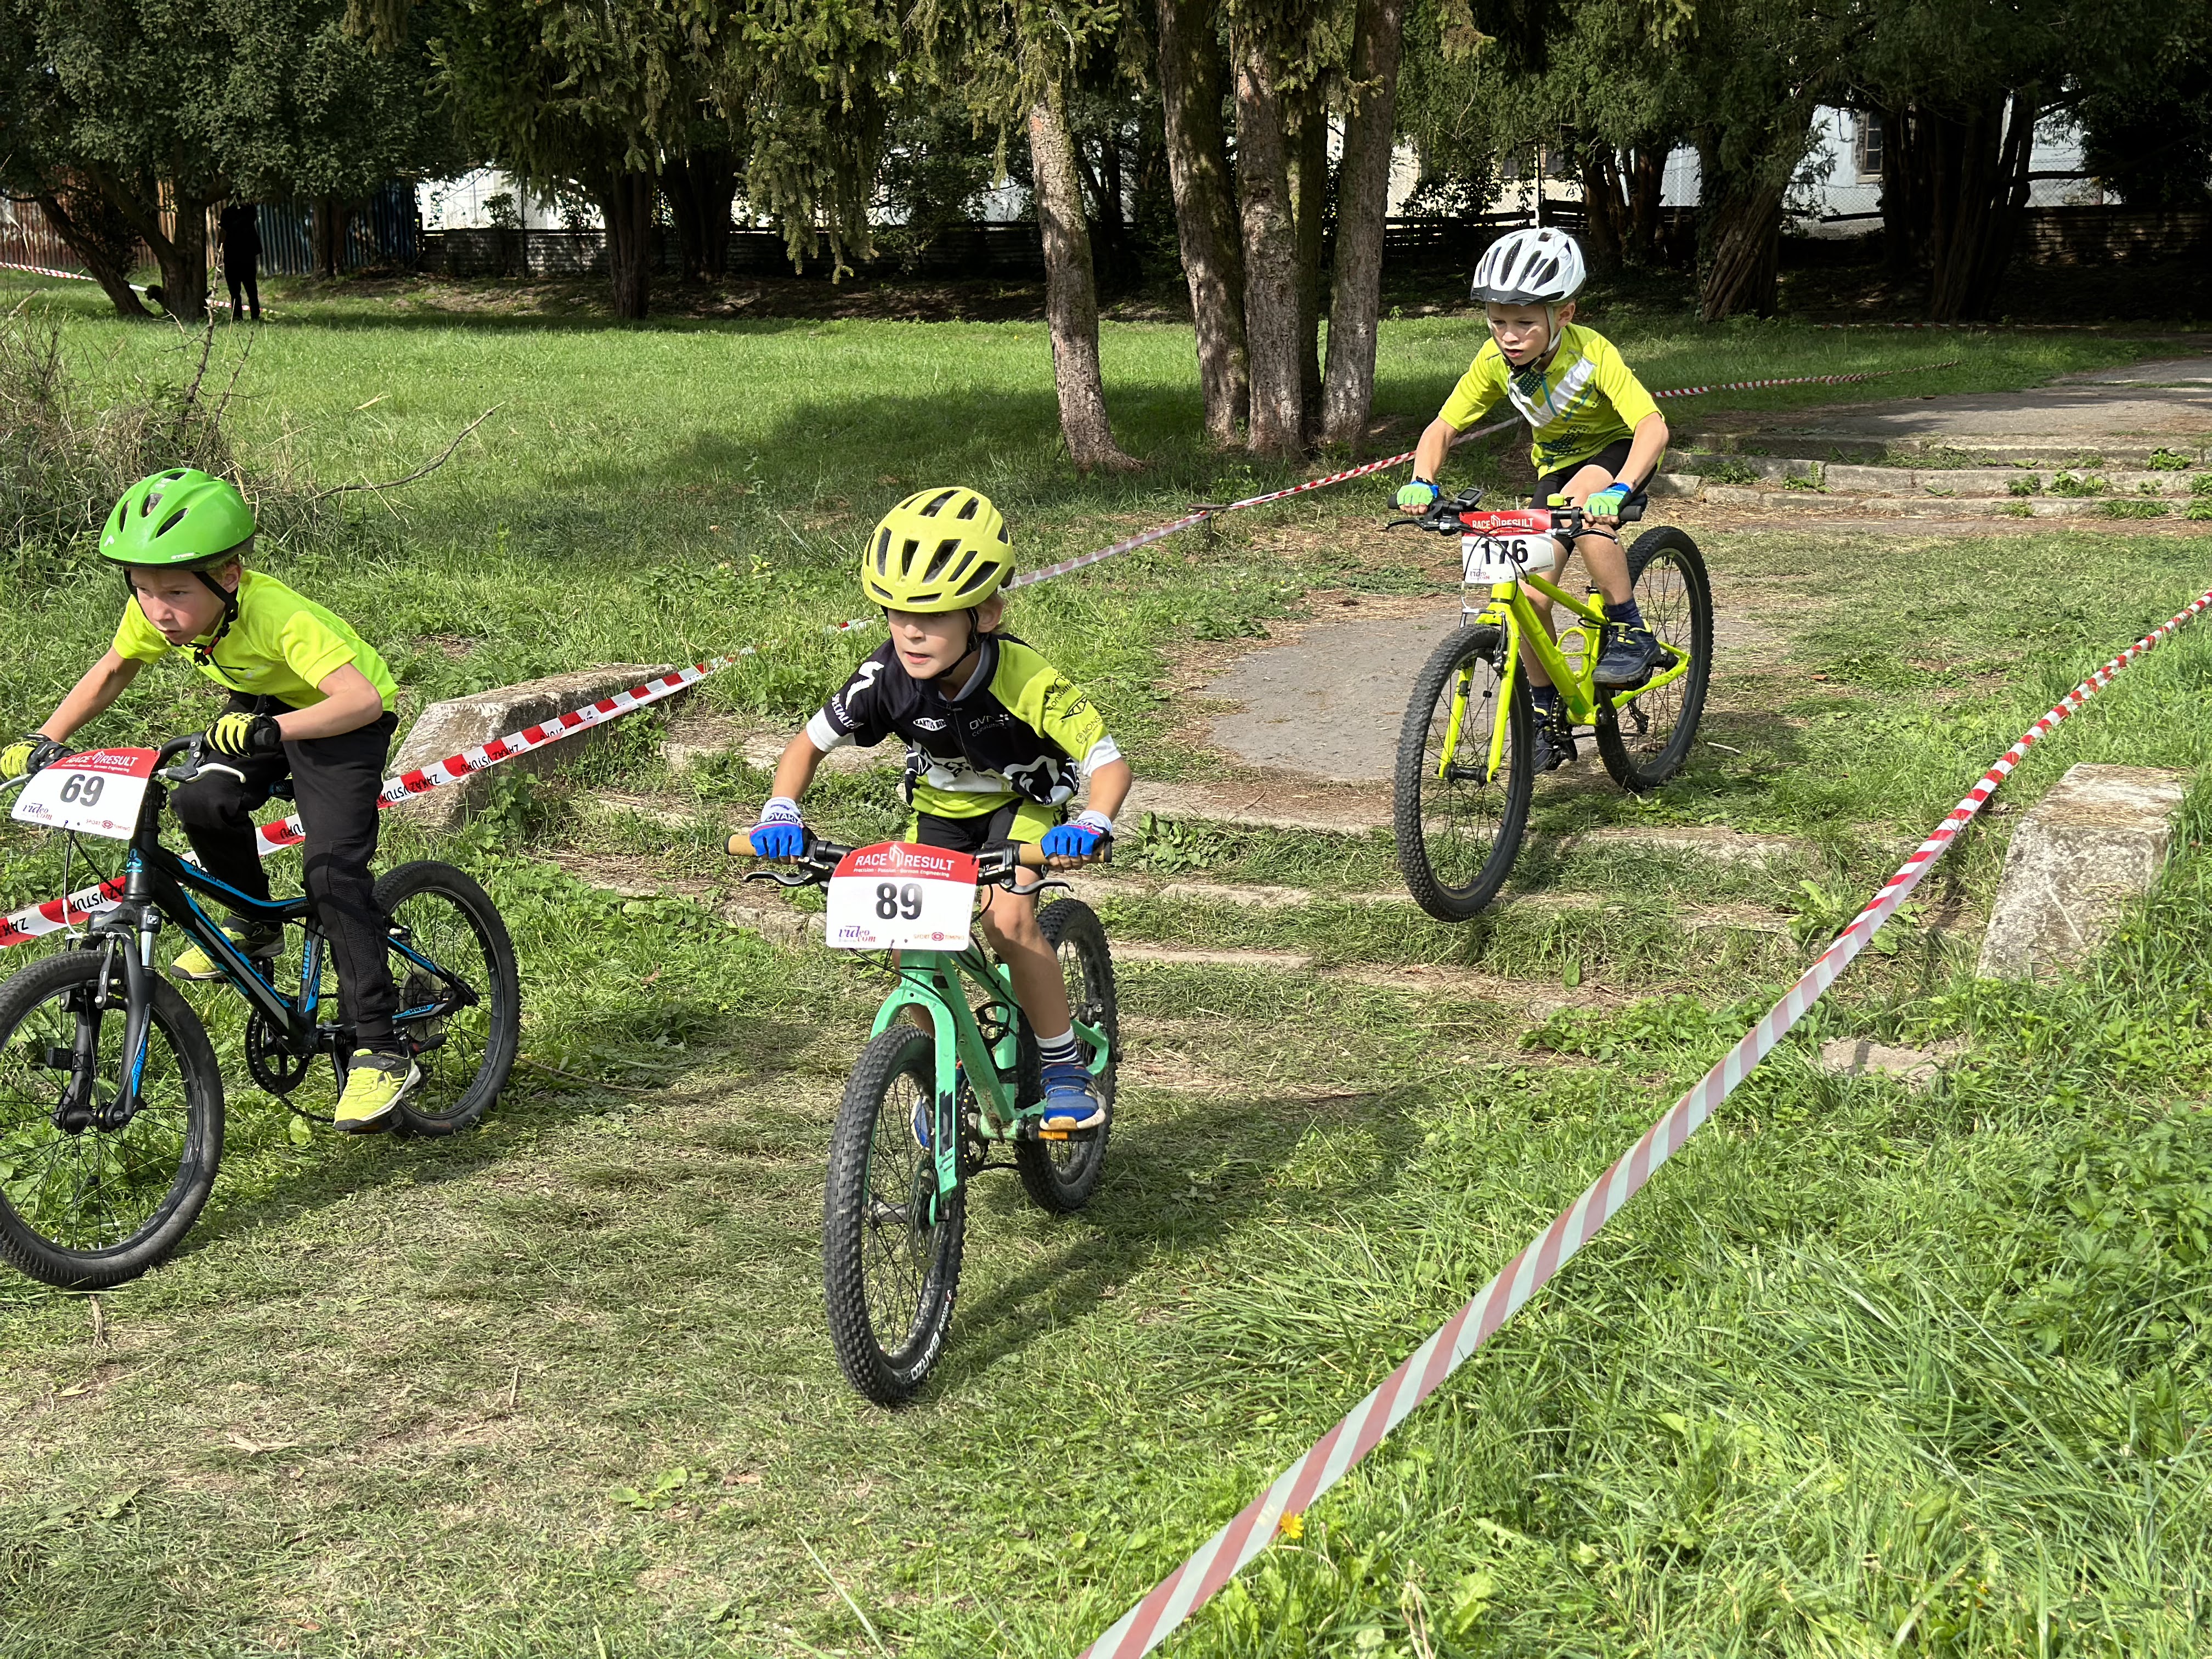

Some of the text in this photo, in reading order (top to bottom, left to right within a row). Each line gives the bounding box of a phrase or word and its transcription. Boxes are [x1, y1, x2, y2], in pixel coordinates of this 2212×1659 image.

[1472, 520, 1491, 529] RACE
[1481, 539, 1528, 565] 176
[99, 755, 139, 766] RESULT
[60, 774, 105, 807] 69
[855, 853, 955, 871] RACE RESULT
[876, 882, 923, 920] 89
